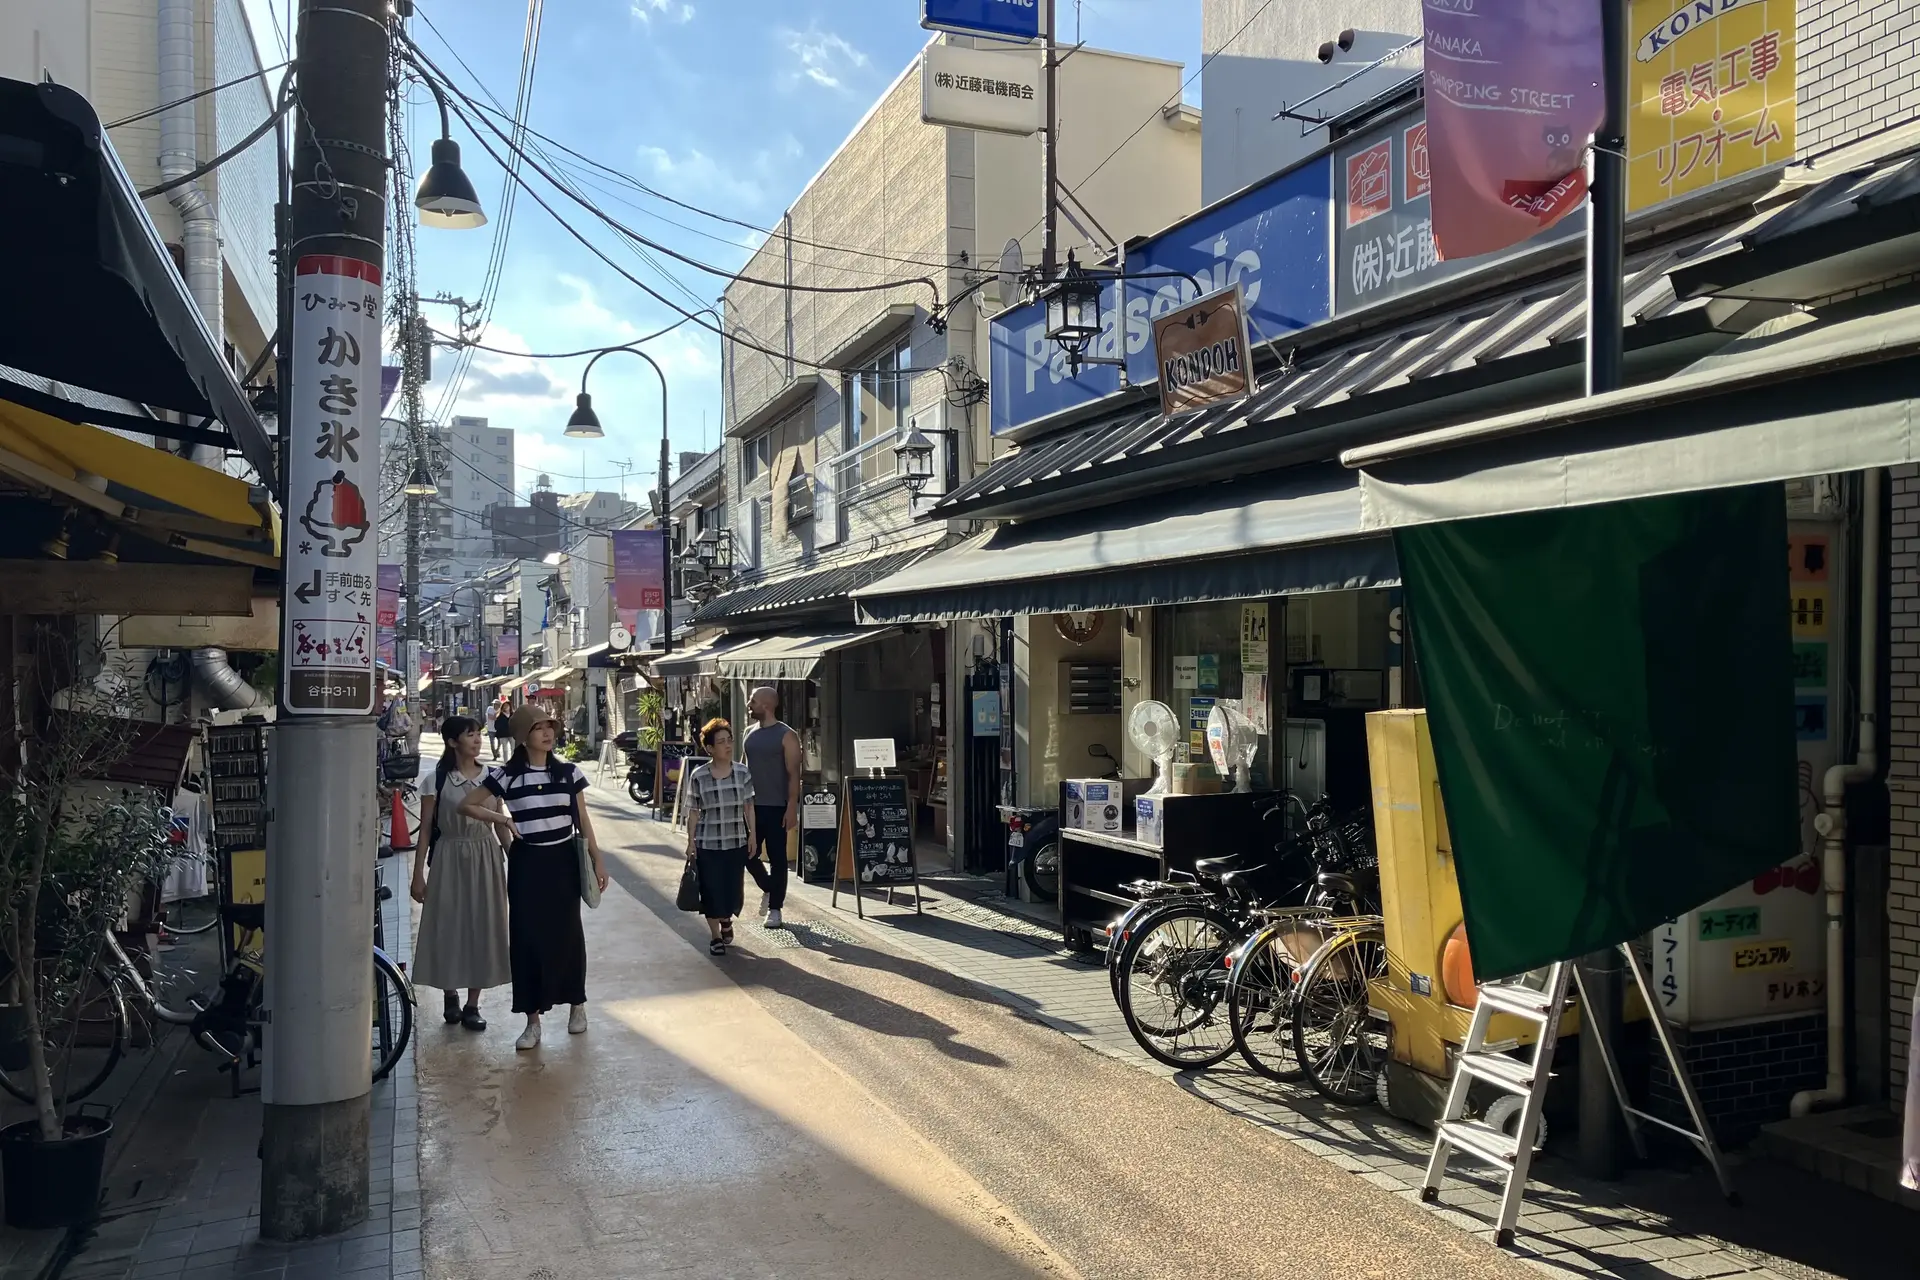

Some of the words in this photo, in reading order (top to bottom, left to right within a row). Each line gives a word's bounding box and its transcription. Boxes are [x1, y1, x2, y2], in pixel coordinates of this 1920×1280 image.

[1426, 29, 1483, 56] YANAKA
[934, 71, 1034, 100] (株)近藤電機商会
[1660, 32, 1780, 116] 電気工事
[1429, 70, 1501, 101] SHOPPING
[1511, 88, 1574, 109] STREET
[1658, 107, 1780, 185] リフォーム
[301, 293, 378, 319] ひみつ堂
[1164, 336, 1239, 393] KONDOH
[314, 326, 361, 463] かき氷
[325, 571, 372, 590] 手前曲る
[325, 589, 371, 606] すぐ先
[308, 685, 357, 697] 谷中3-11
[1702, 912, 1760, 935] オーディオ
[1734, 946, 1791, 969] ビジュアル
[1767, 979, 1825, 1001] テレホン
